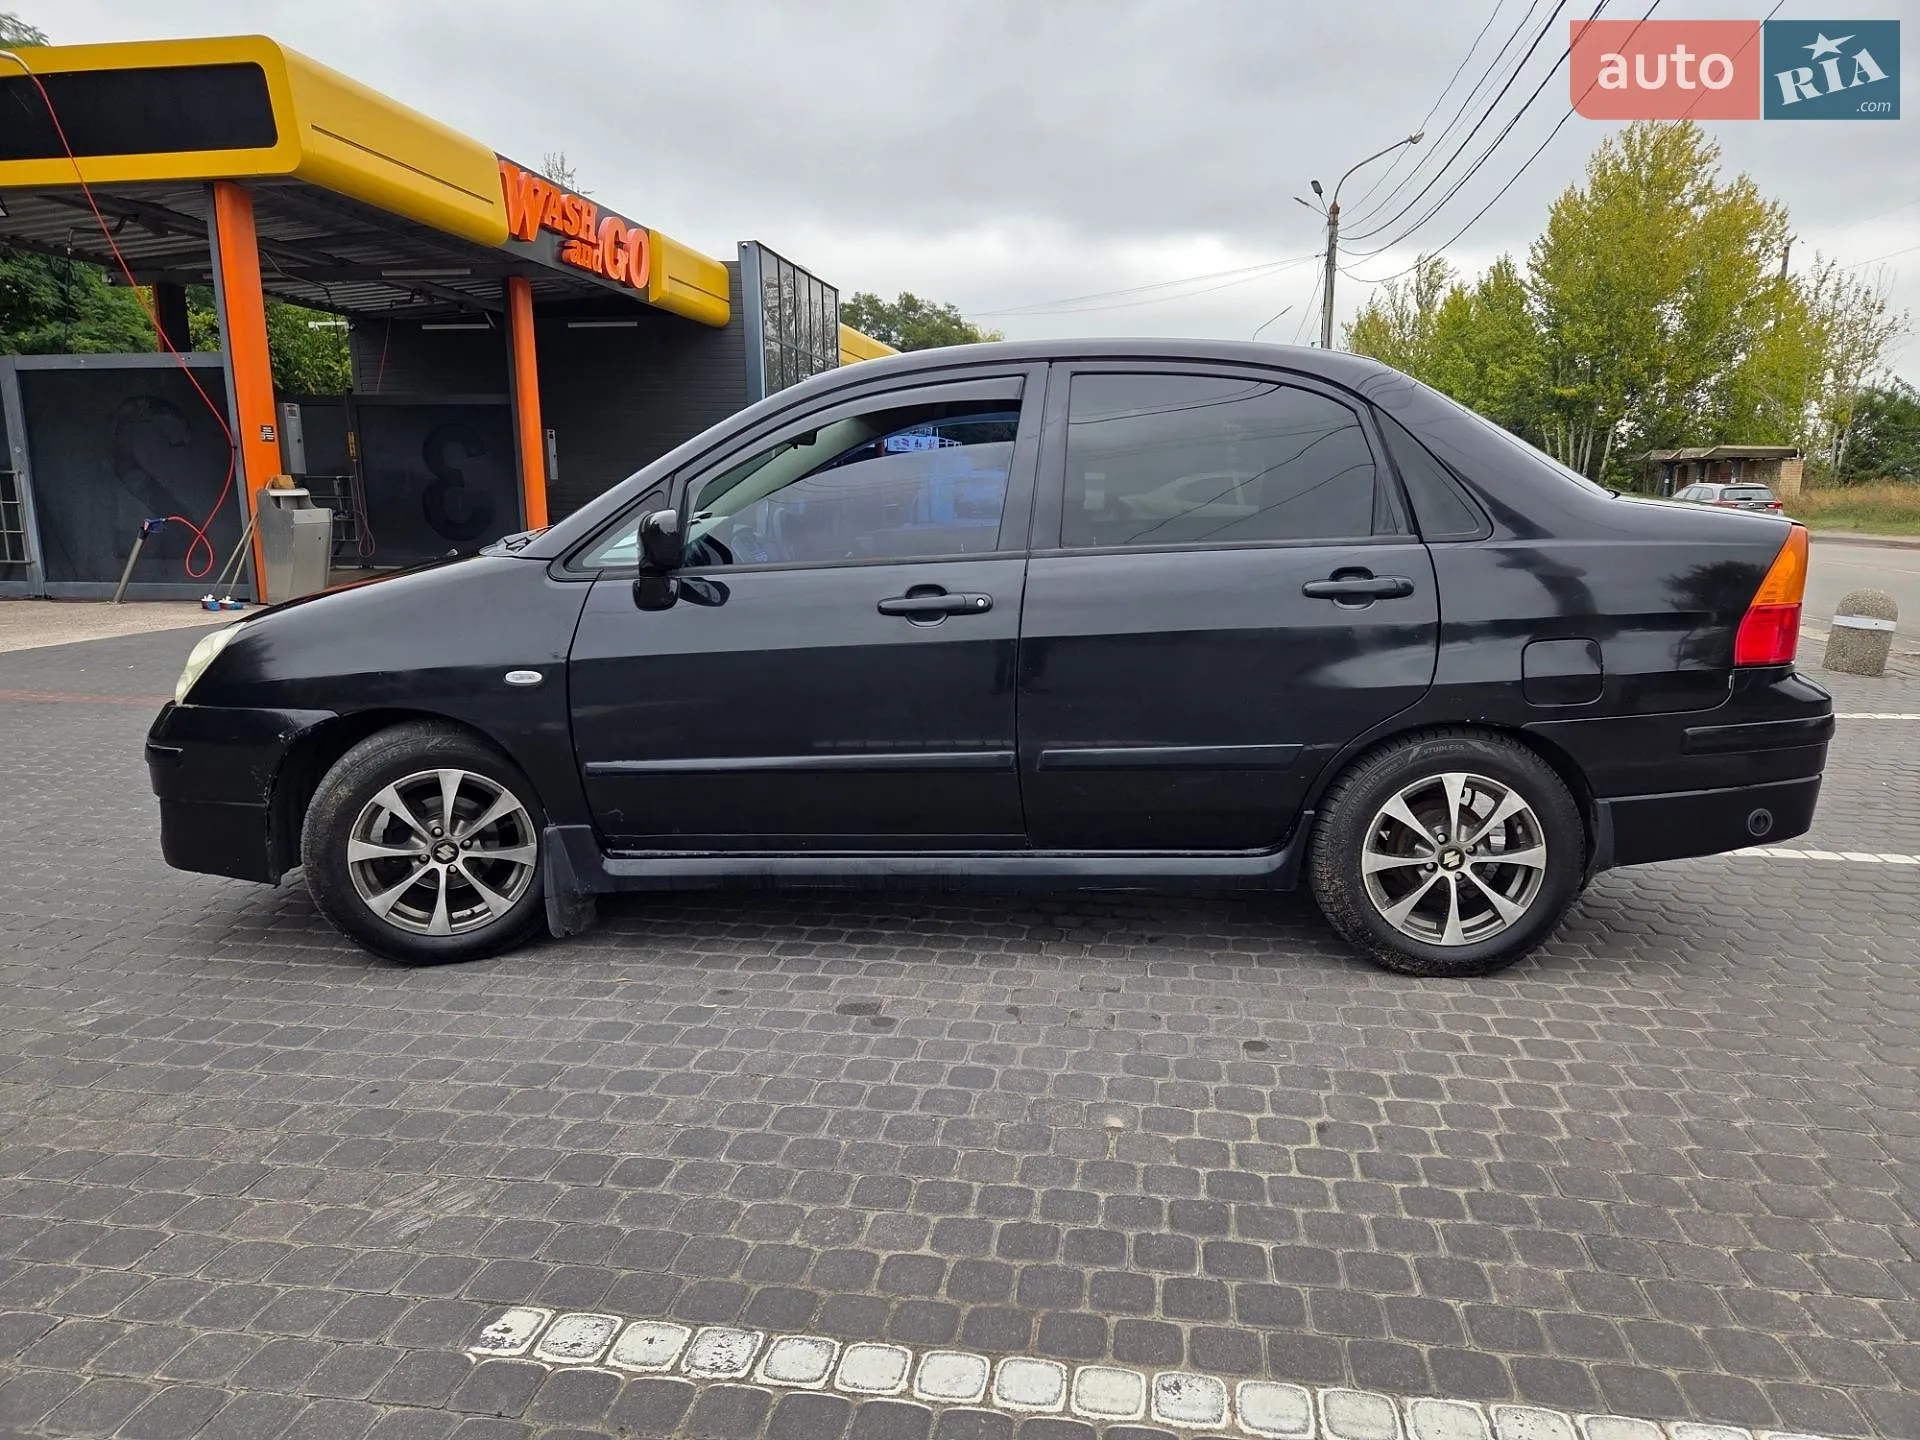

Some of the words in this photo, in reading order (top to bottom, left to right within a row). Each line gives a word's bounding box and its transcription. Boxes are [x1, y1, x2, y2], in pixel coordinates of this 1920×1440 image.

[498, 160, 599, 246] WASH
[562, 240, 604, 274] and
[598, 216, 650, 289] GO
